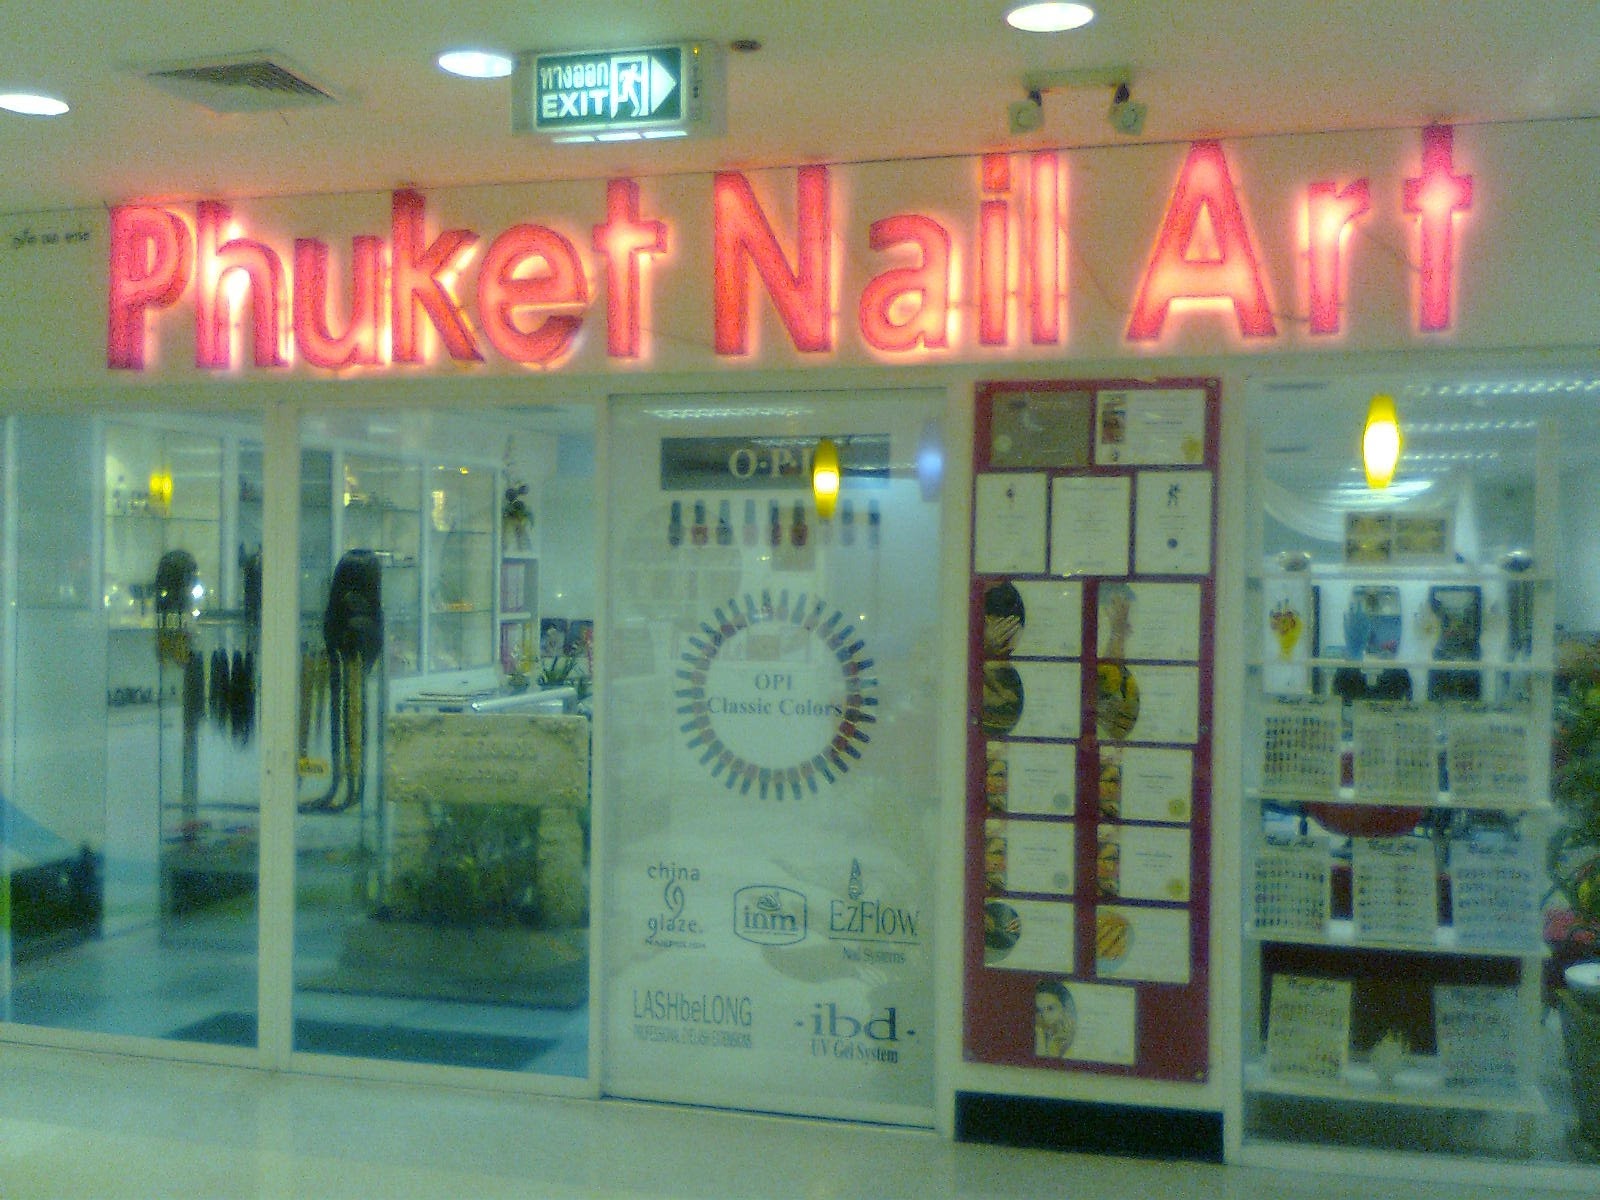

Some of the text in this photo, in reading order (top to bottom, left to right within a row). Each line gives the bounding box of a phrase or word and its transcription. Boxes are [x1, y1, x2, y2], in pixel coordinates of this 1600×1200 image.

[540, 62, 609, 90] ทางออก
[542, 89, 609, 119] EXIT
[106, 124, 1474, 371] Phuket Nail Art
[754, 673, 793, 691] OPI
[707, 697, 843, 716] Classic Colors
[647, 862, 700, 881] china
[811, 1002, 899, 1042] ibd
